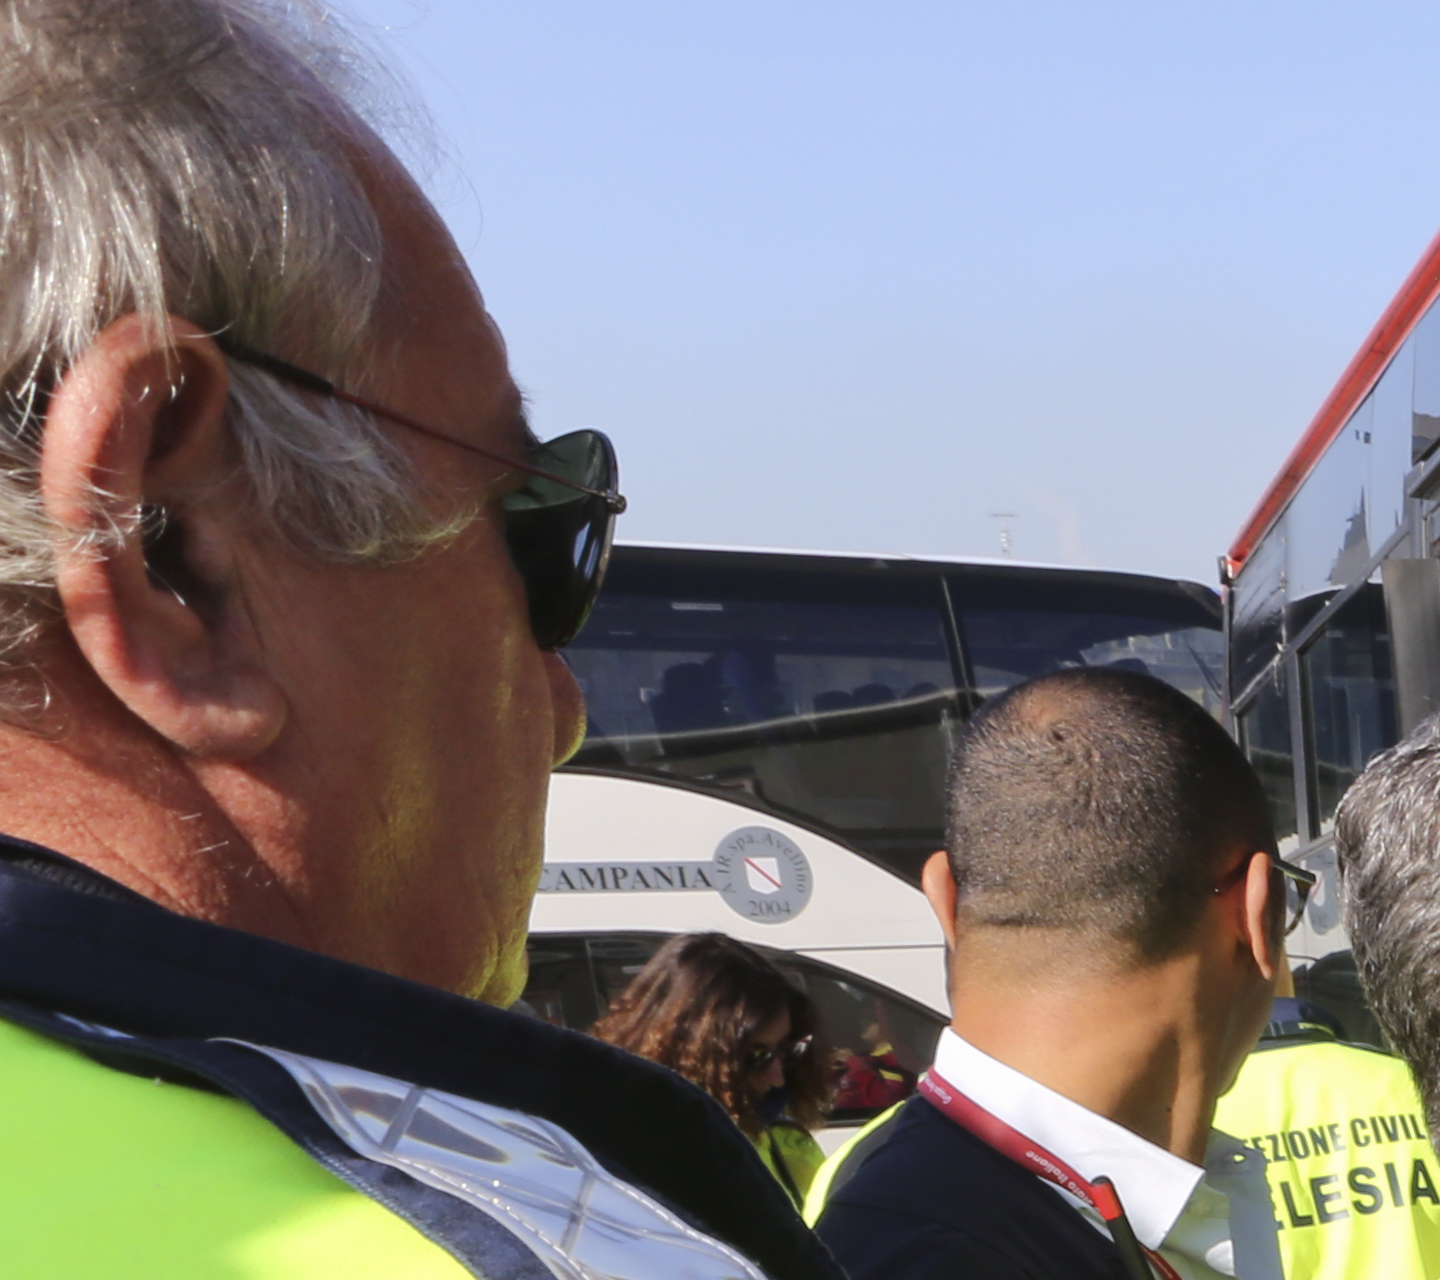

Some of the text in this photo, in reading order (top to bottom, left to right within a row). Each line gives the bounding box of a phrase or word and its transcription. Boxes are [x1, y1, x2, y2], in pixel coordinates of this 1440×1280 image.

[749, 900, 793, 916] 2004
[1243, 1113, 1428, 1164] EZIONE CIVIL
[1025, 1150, 1069, 1185] Italiane
